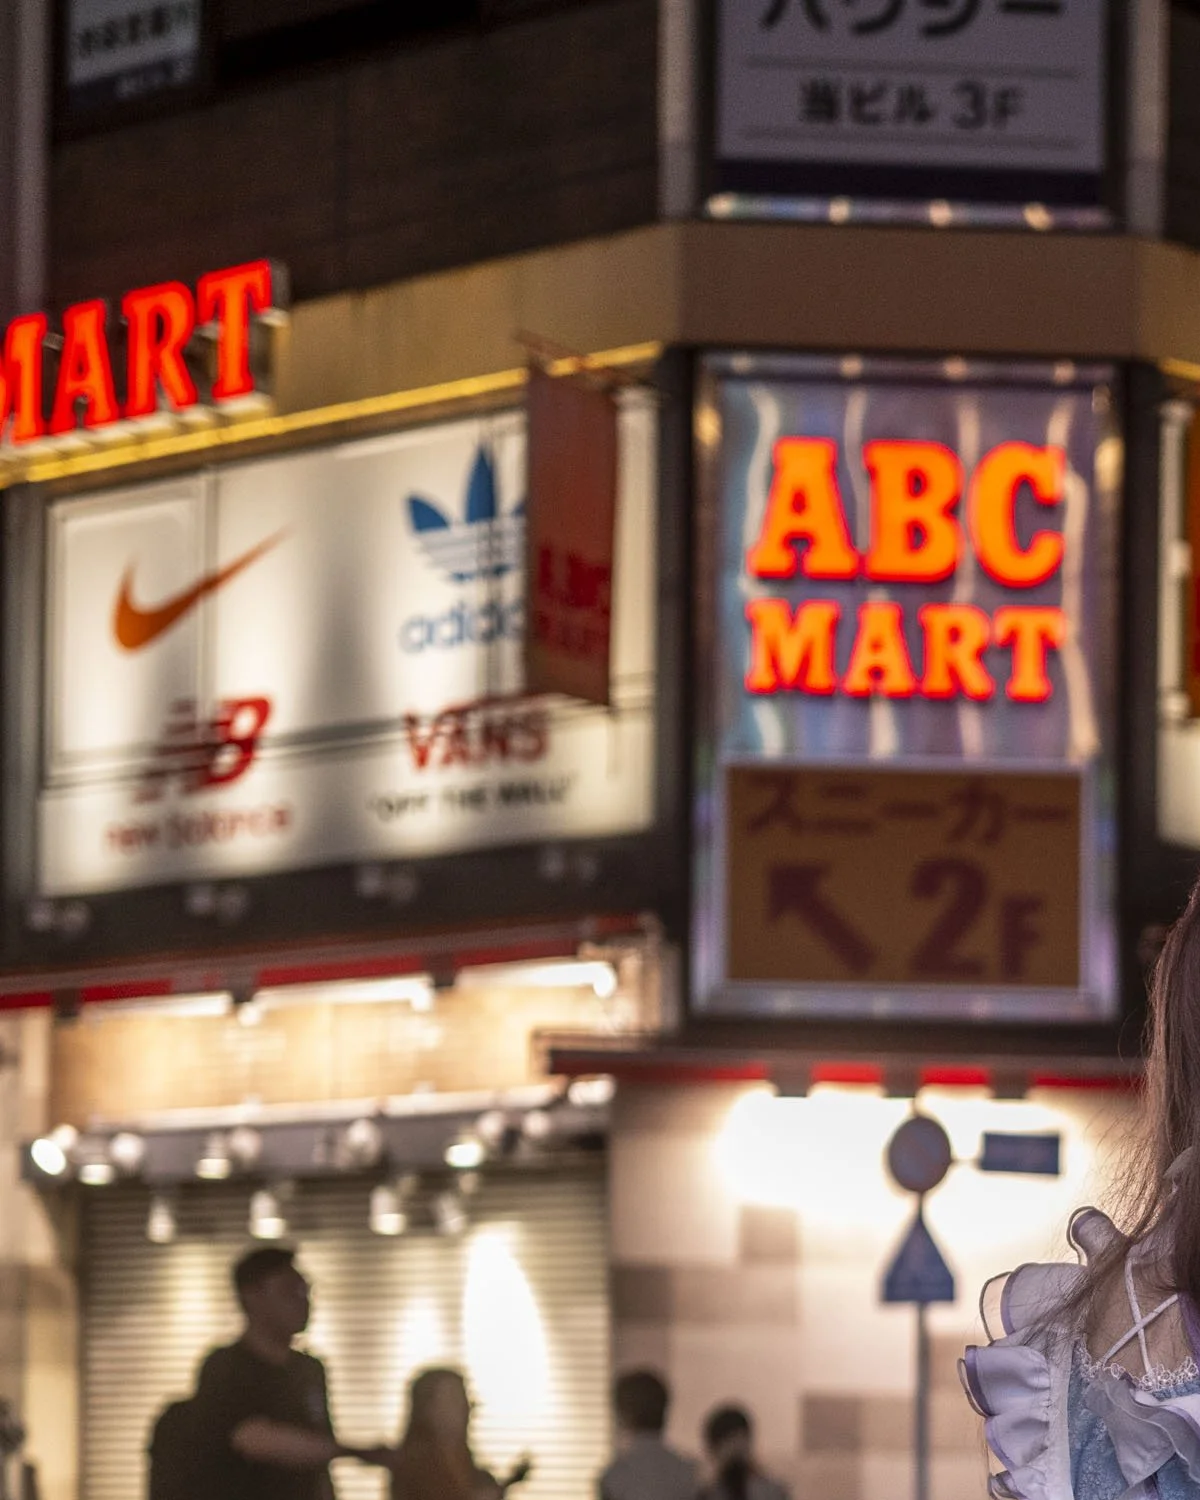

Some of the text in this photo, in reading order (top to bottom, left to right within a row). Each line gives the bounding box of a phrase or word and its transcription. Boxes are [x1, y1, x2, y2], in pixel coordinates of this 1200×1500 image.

[746, 435, 1066, 588] ABC
[745, 599, 1066, 701] MART
[747, 776, 1070, 847] スニーカー
[910, 857, 1045, 977] 2F
